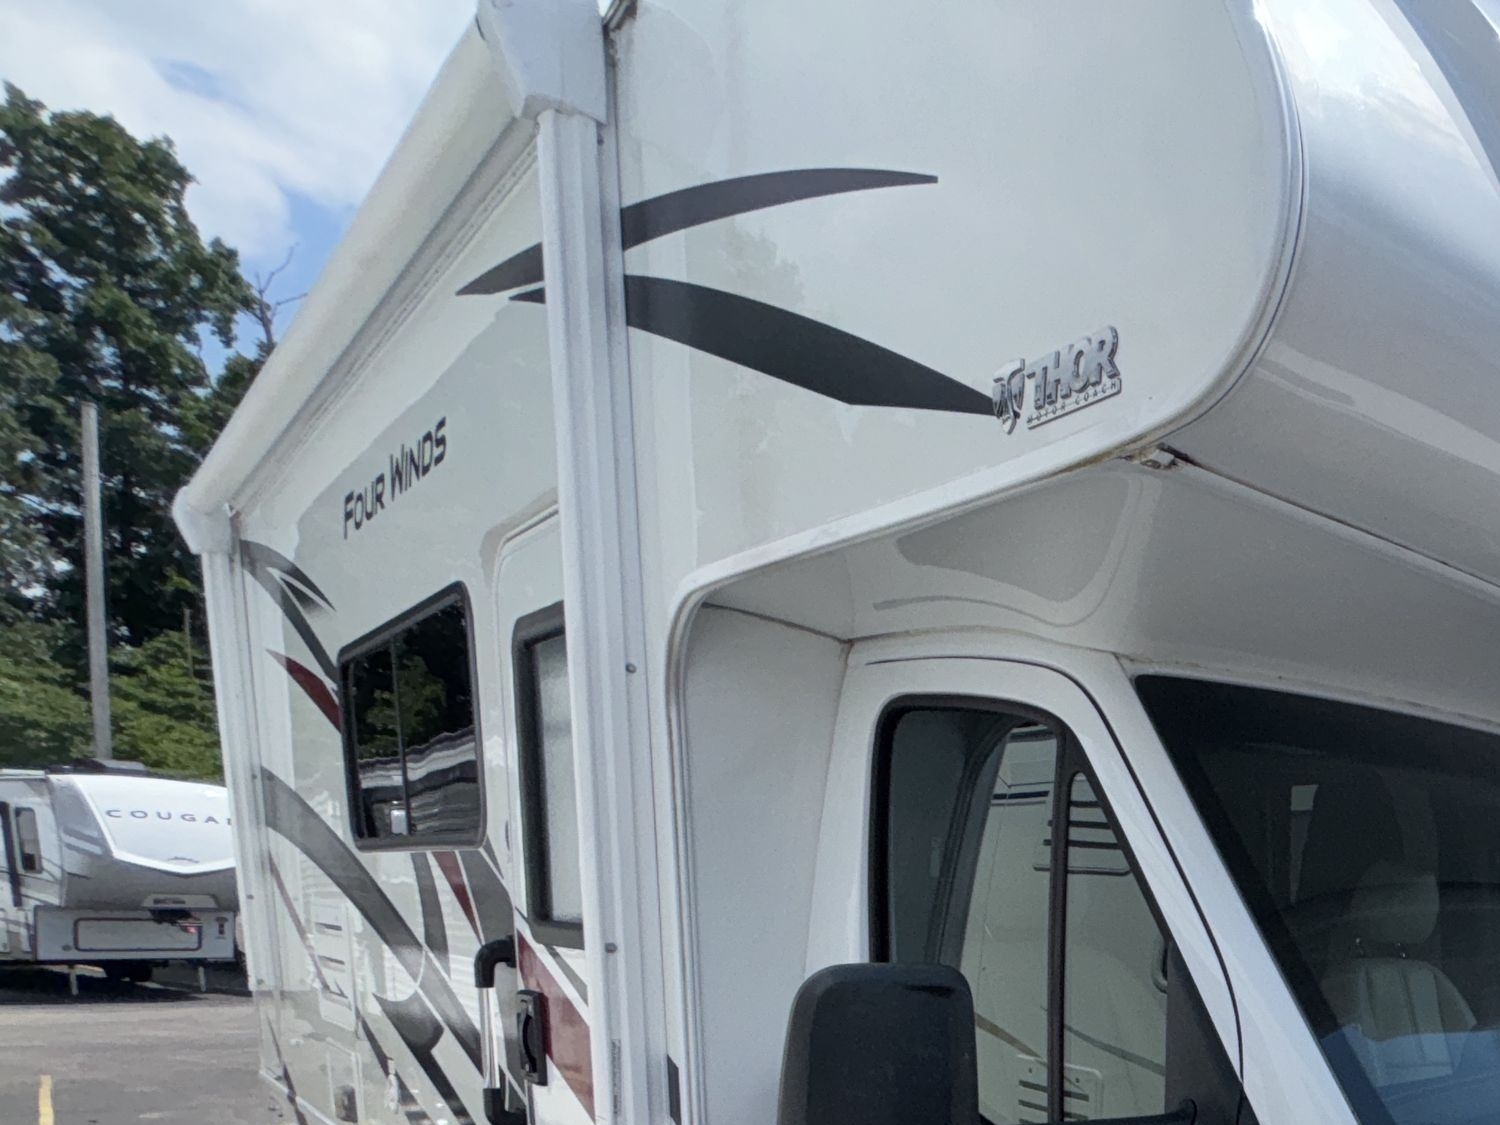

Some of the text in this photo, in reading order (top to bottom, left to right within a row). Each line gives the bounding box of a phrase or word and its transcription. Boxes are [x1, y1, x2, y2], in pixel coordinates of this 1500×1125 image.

[1026, 325, 1121, 410] THOR
[343, 415, 447, 540] FOUR WINDS
